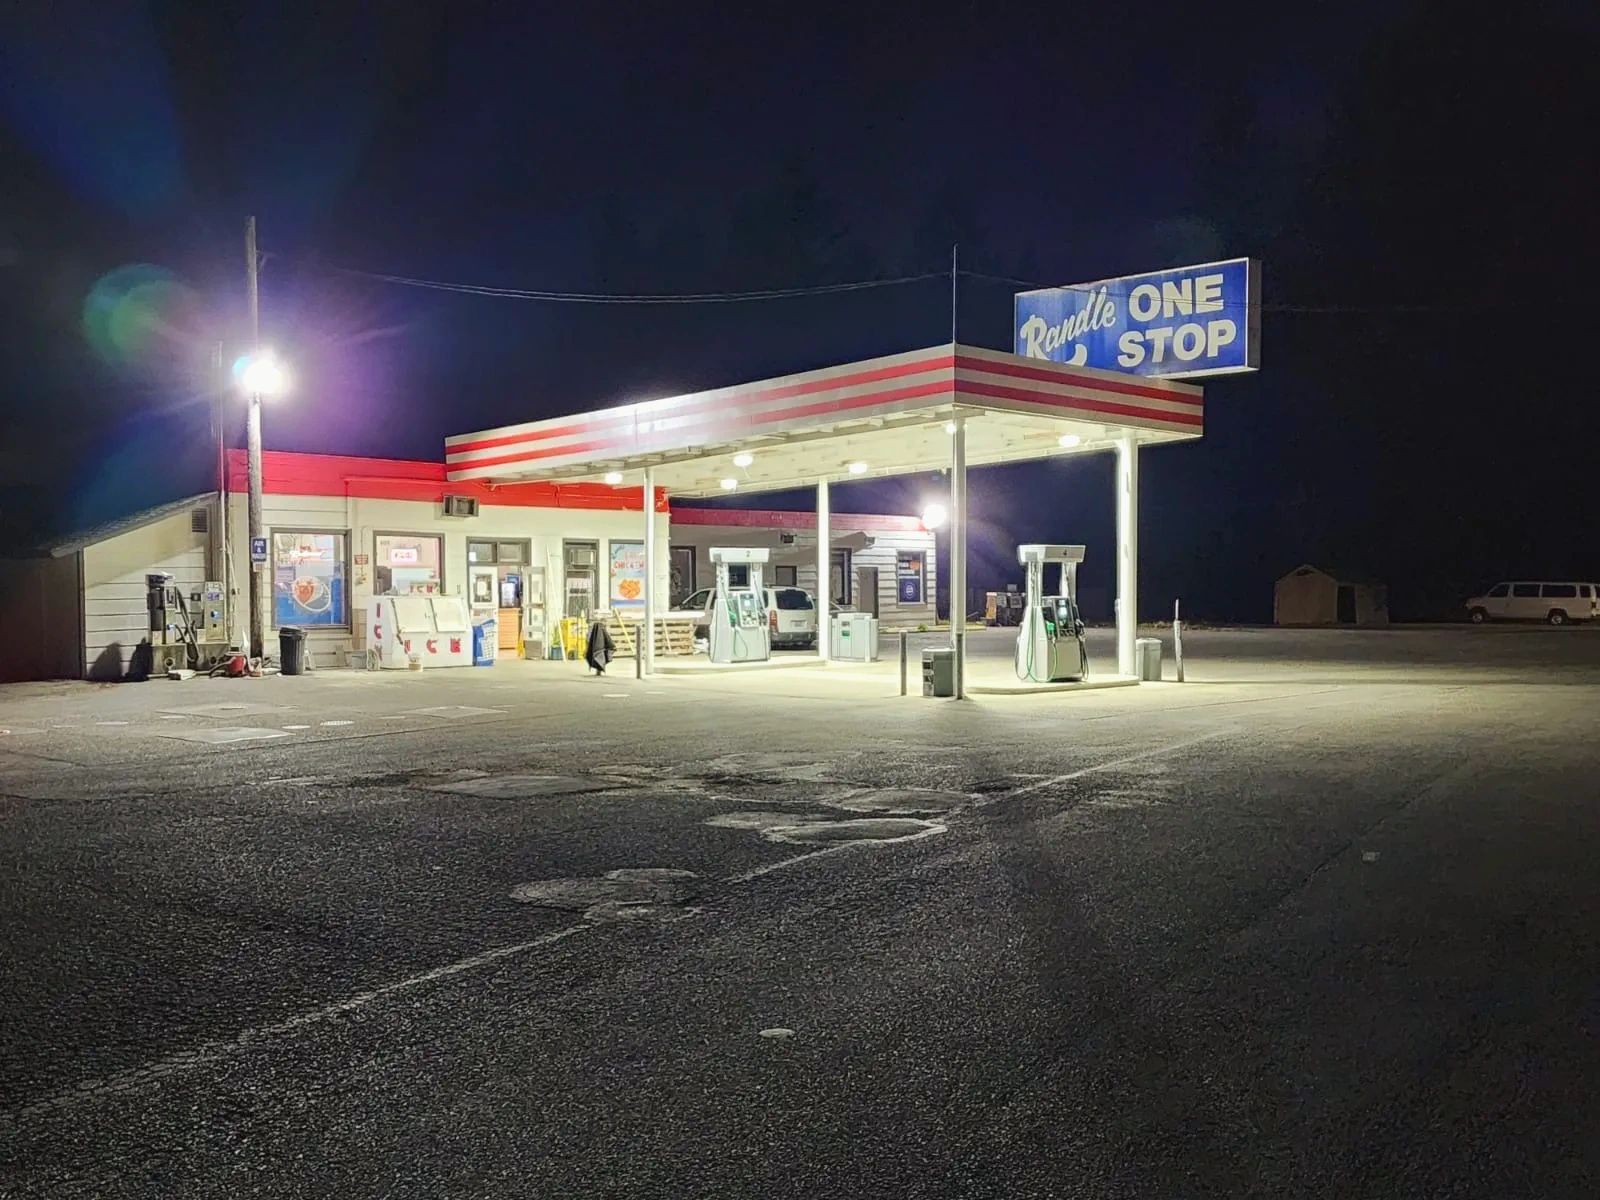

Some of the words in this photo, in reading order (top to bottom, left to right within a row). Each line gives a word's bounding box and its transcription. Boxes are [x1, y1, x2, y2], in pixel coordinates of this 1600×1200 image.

[1128, 273, 1224, 322] ONE
[1020, 286, 1116, 360] Randle
[1118, 319, 1236, 367] STOP
